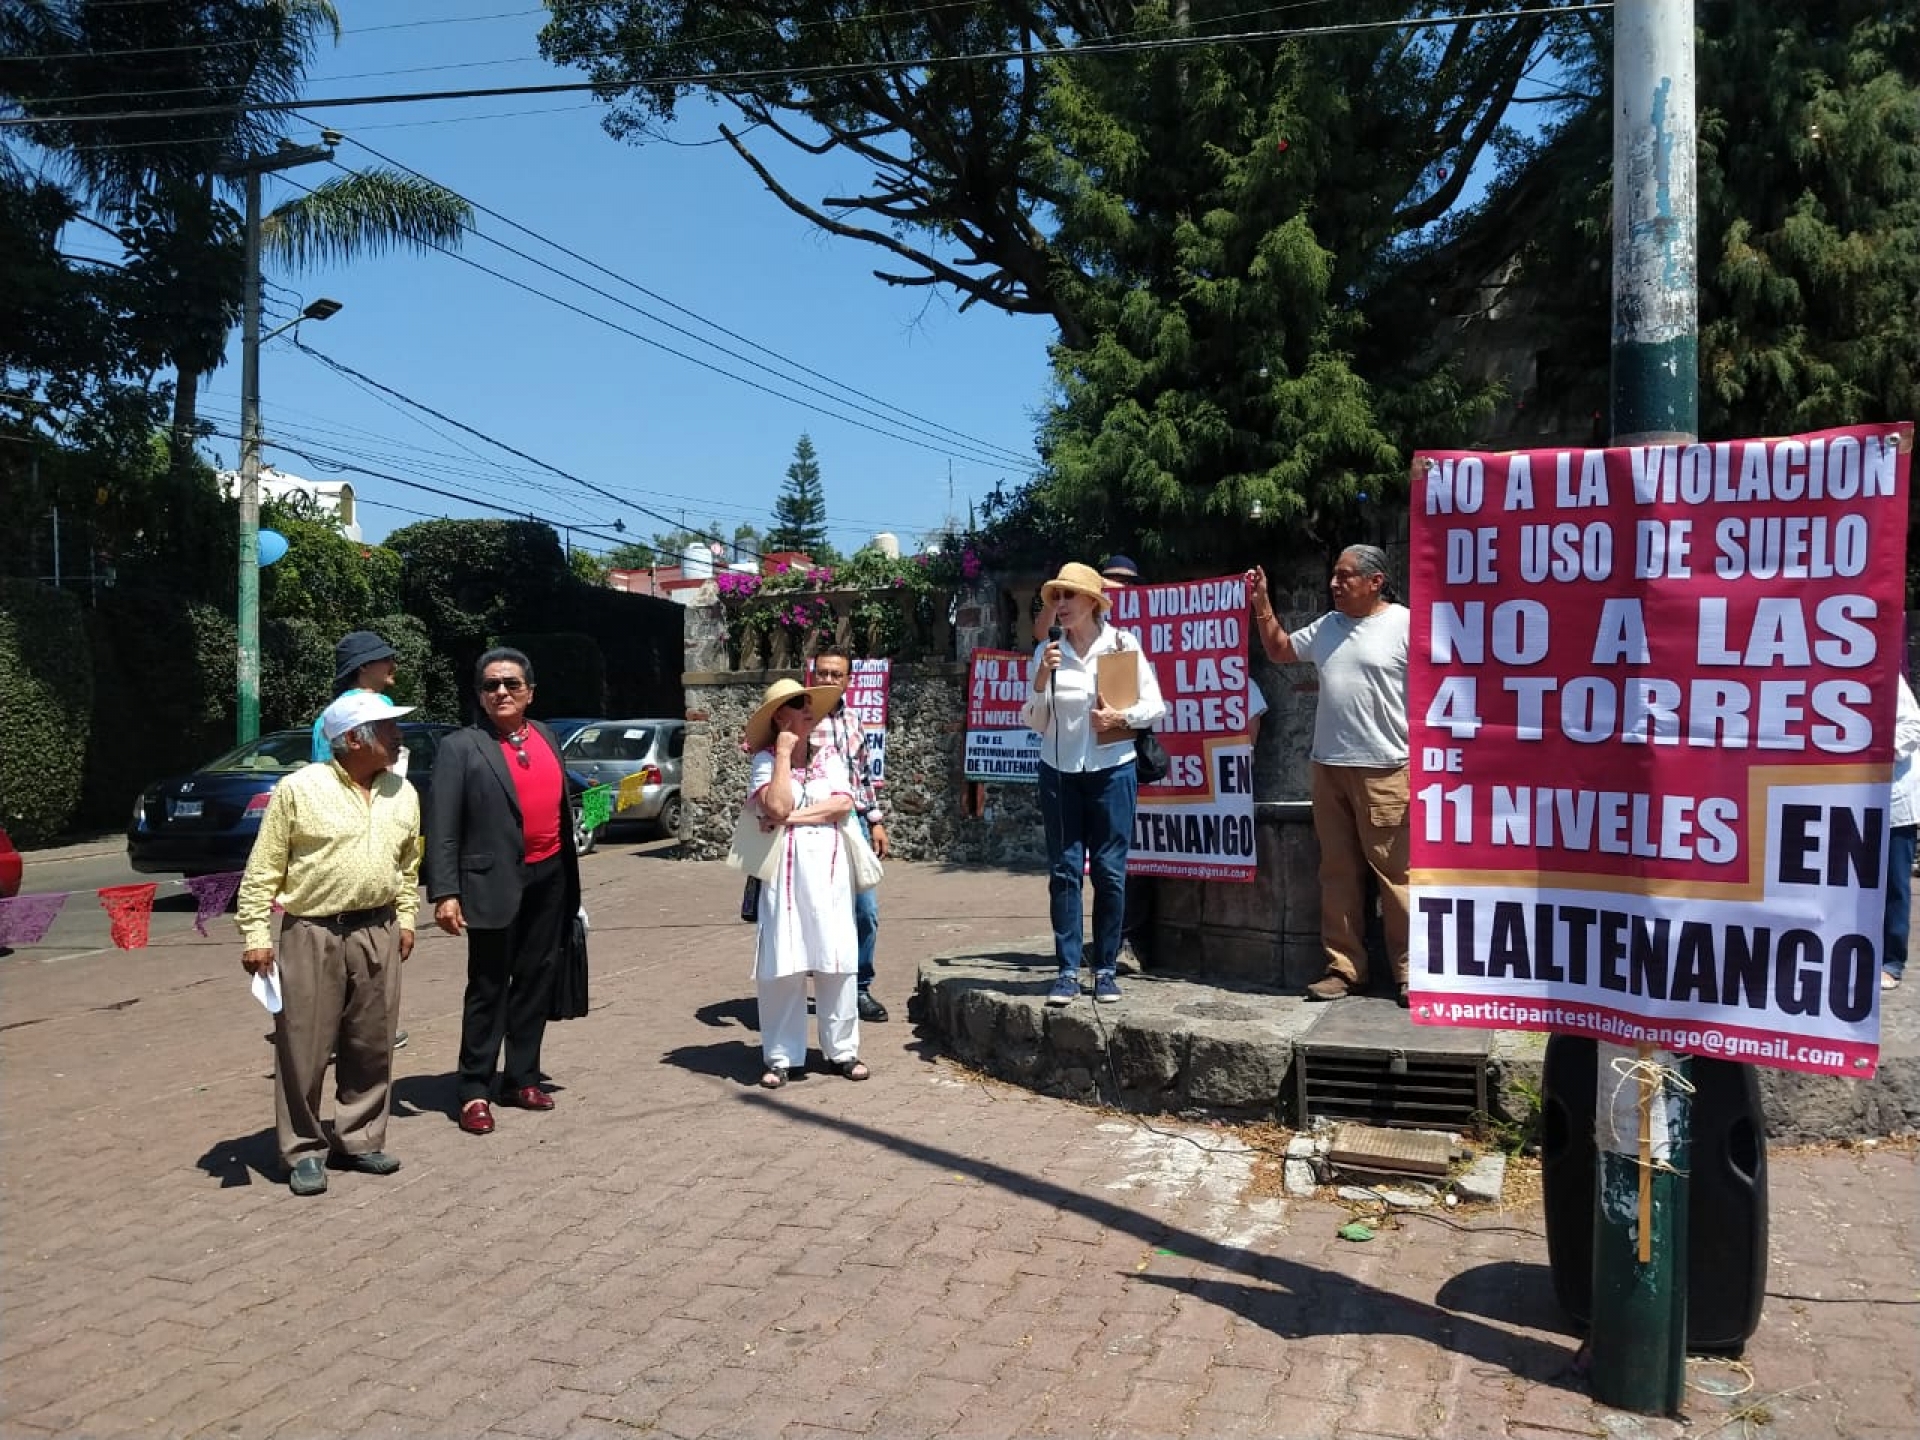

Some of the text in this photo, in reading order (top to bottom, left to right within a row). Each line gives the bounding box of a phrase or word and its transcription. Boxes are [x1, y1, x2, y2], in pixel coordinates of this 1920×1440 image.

[1425, 435, 1898, 515] NO A LA VIOLACION
[1446, 513, 1868, 584] DE USO DE SUELO
[1118, 590, 1141, 620] LA
[1147, 580, 1246, 617] VIOLACION
[1151, 623, 1173, 653] DE
[1181, 617, 1240, 651] SUELO
[1430, 594, 1878, 668] NO A LAS
[973, 680, 985, 700] 4
[1175, 656, 1246, 693] LAS
[854, 690, 884, 706] LAS
[1152, 695, 1246, 732] RRES
[1425, 676, 1874, 754] 4 TORRES
[1219, 755, 1251, 794] EN
[1422, 746, 1463, 773] DE
[1130, 813, 1254, 857] LTENANGO
[1417, 782, 1739, 864] 11 NIVELES
[1778, 803, 1884, 889] EN
[1418, 897, 1876, 1023] TLALTENANGO
[1433, 1001, 1846, 1068] v.participantestlaltenango@gmail.com
